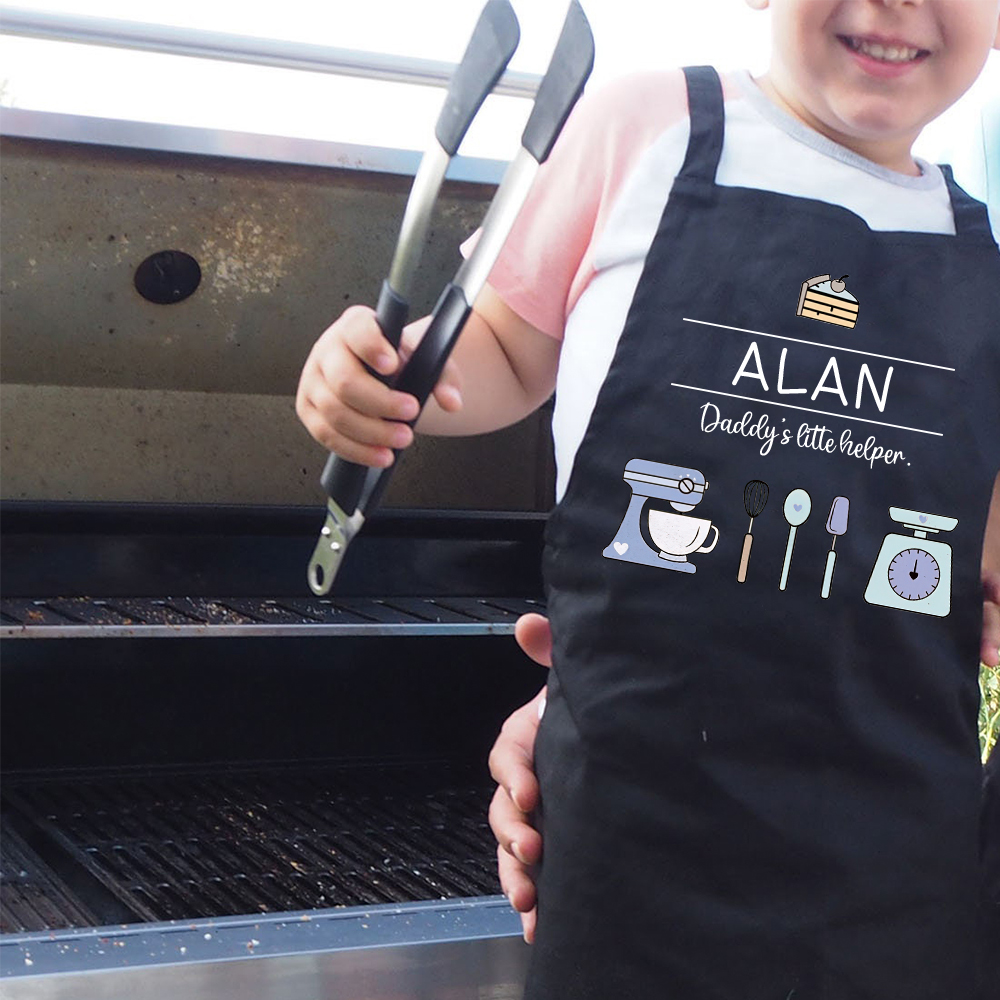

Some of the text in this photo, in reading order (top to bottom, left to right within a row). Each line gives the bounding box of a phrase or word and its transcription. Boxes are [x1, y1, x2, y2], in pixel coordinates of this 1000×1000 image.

[731, 341, 894, 413] ALAN
[700, 402, 911, 469] Daddy's litte helper.
